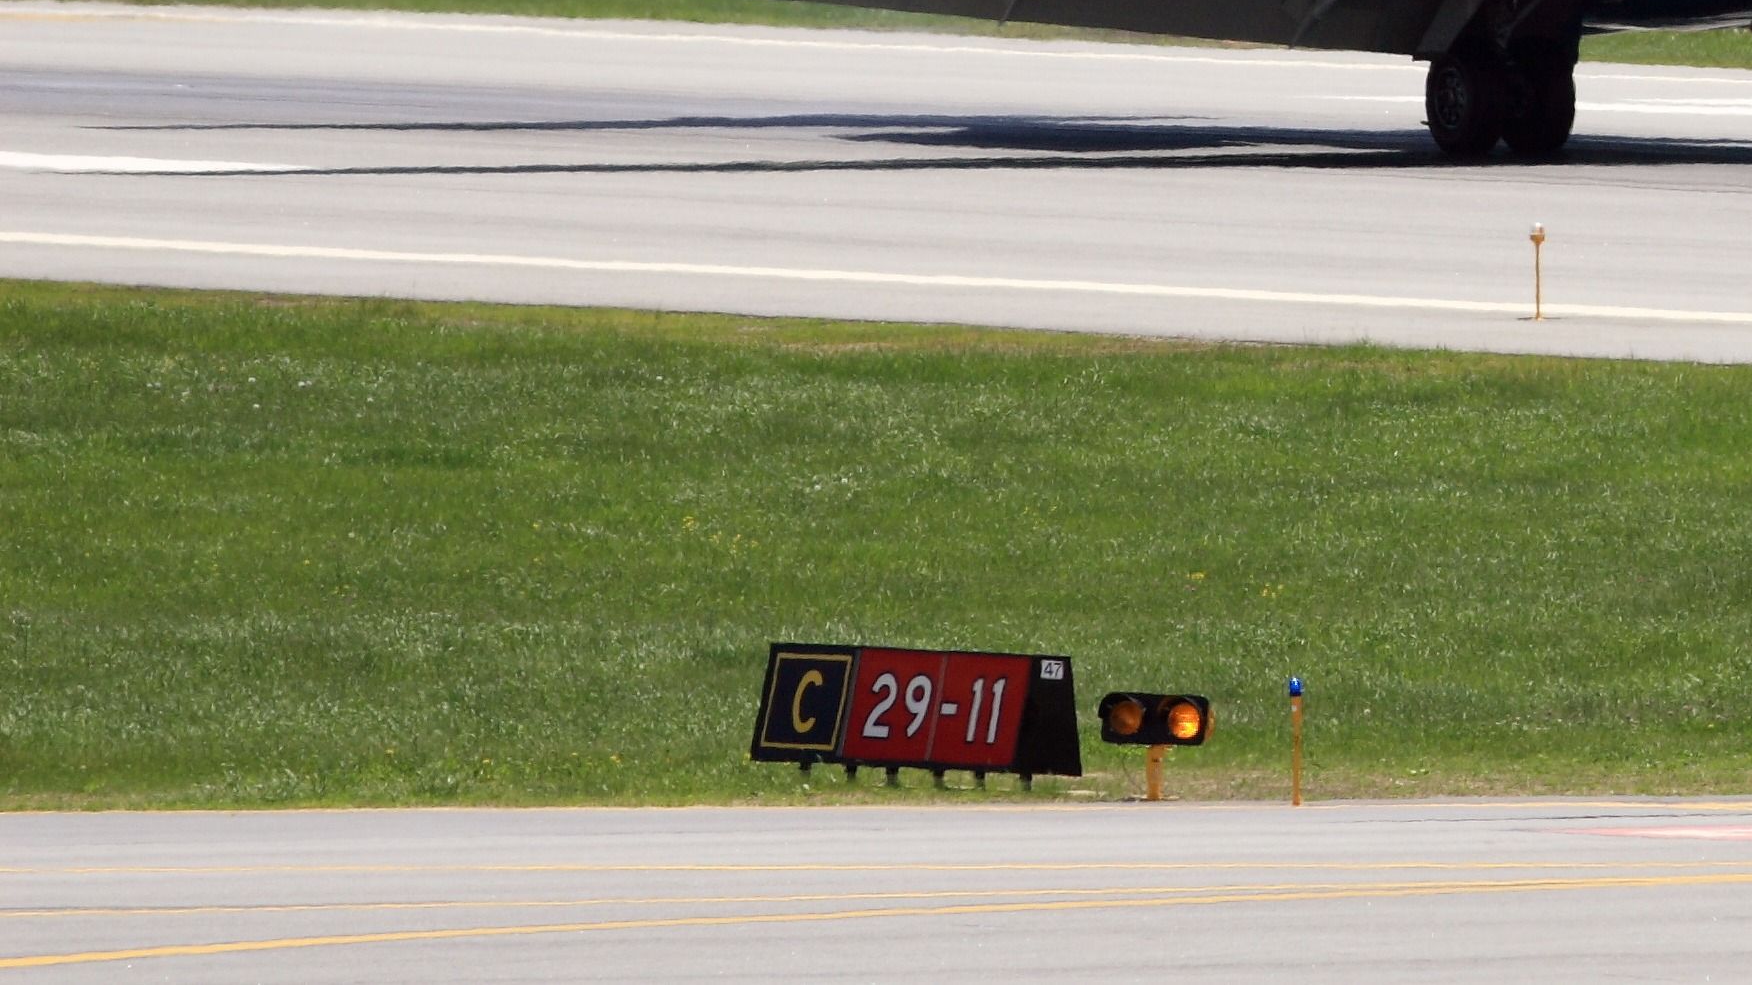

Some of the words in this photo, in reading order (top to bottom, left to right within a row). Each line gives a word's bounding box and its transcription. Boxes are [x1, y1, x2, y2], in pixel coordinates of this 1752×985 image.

[1044, 662, 1062, 679] 47
[791, 669, 823, 734] C
[862, 672, 1006, 744] 29-11
